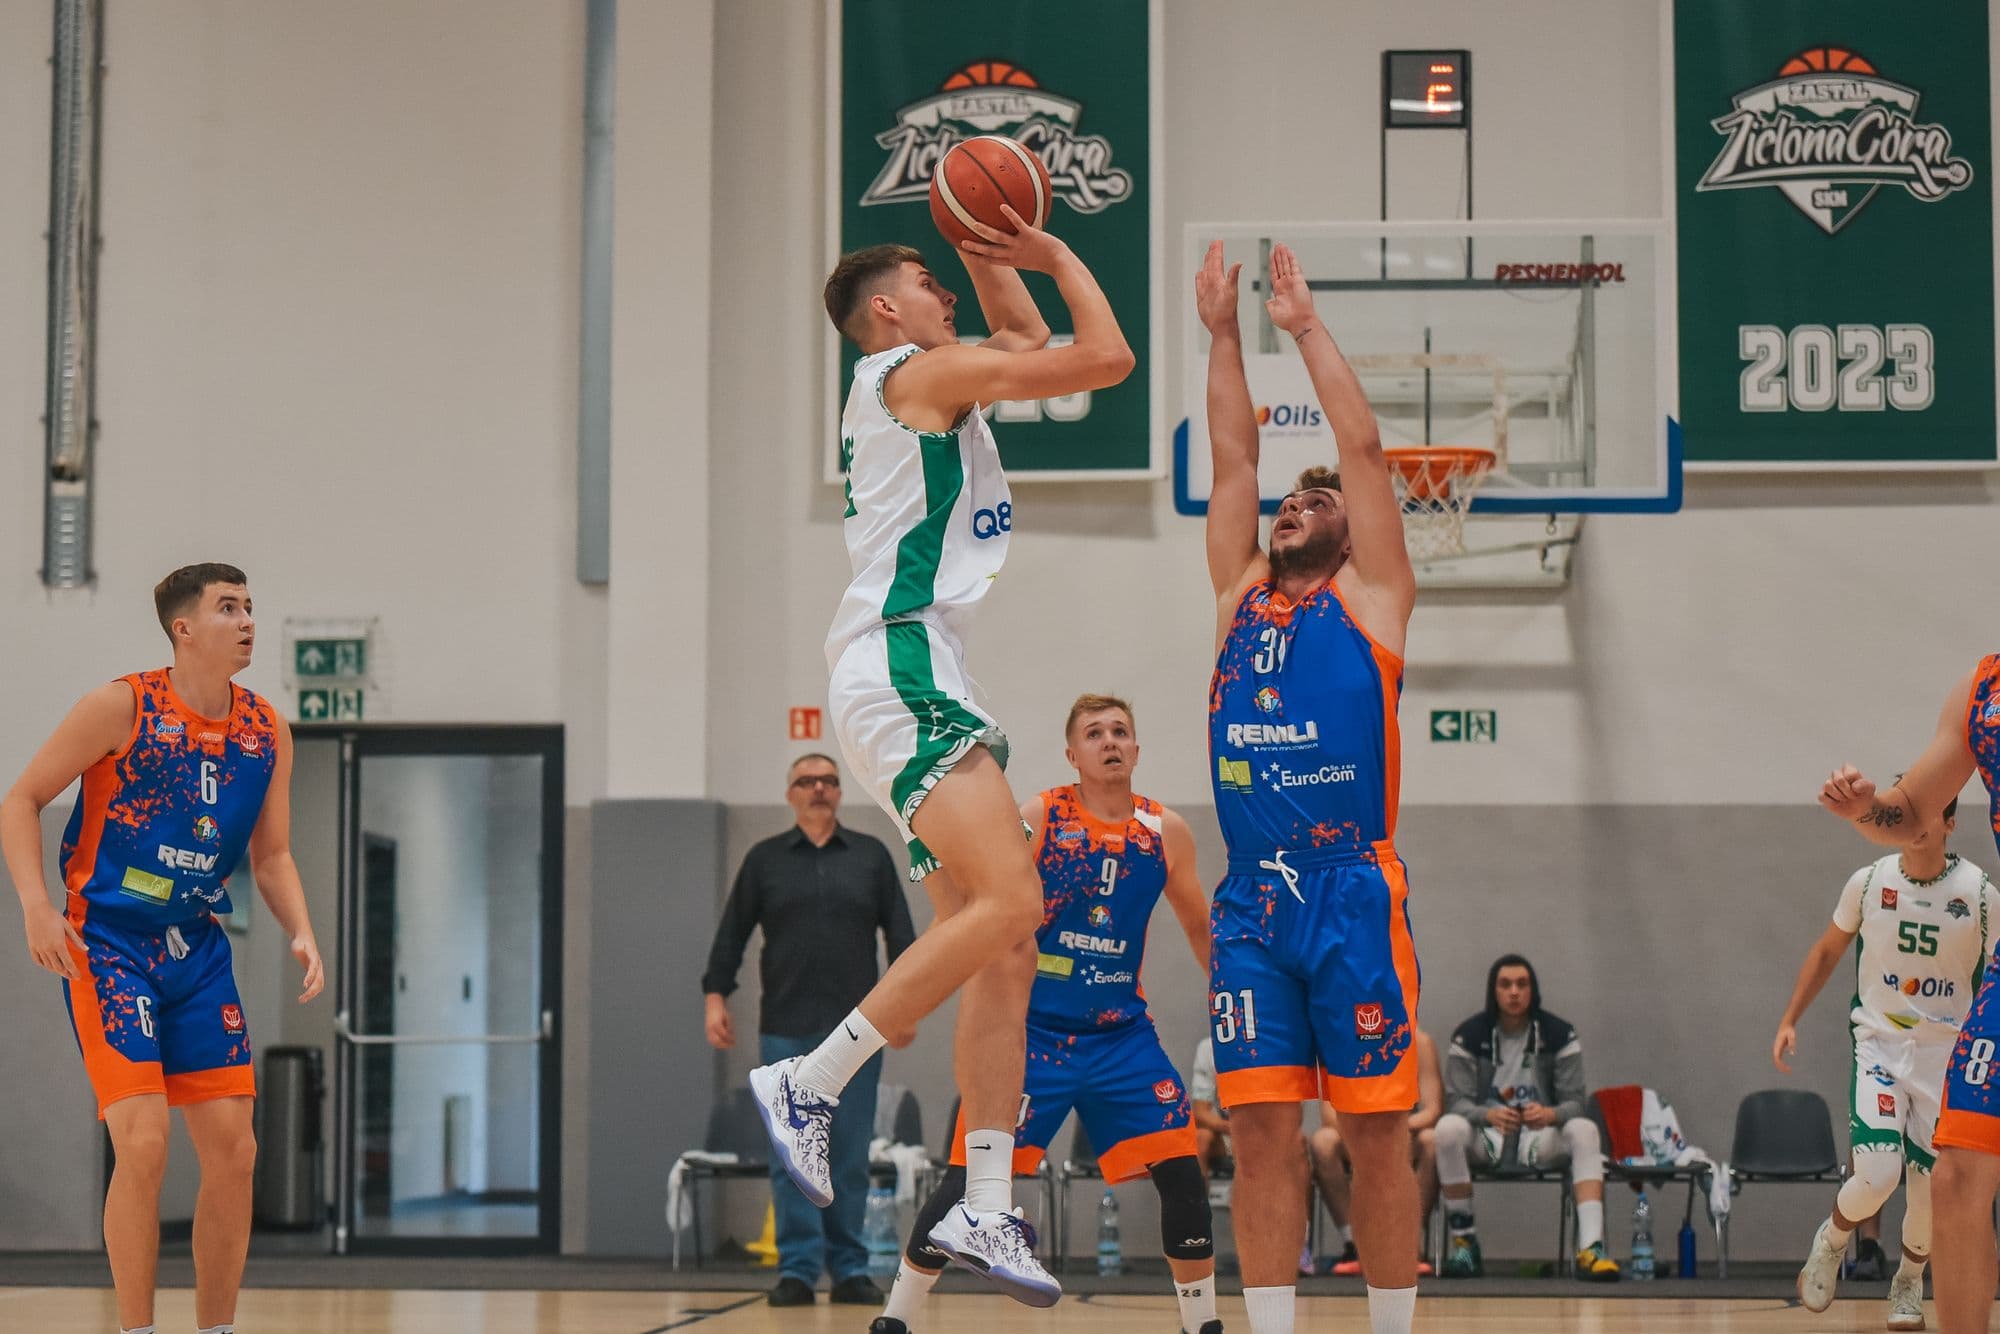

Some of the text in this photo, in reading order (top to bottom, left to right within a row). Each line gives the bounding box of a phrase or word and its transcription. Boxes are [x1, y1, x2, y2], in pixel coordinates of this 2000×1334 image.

[1739, 324, 1934, 412] 2023
[1274, 405, 1321, 426] Oils
[972, 501, 1011, 540] Q8
[1227, 720, 1319, 748] REMLI
[201, 760, 217, 805] 6
[1281, 766, 1355, 786] EuroCom
[1099, 857, 1118, 896] 9
[1058, 930, 1127, 954] REMLI
[1898, 920, 1939, 956] 55
[1921, 977, 1954, 997] Oils
[136, 995, 153, 1037] 6
[1215, 989, 1256, 1043] 31
[1965, 1038, 1995, 1085] 8
